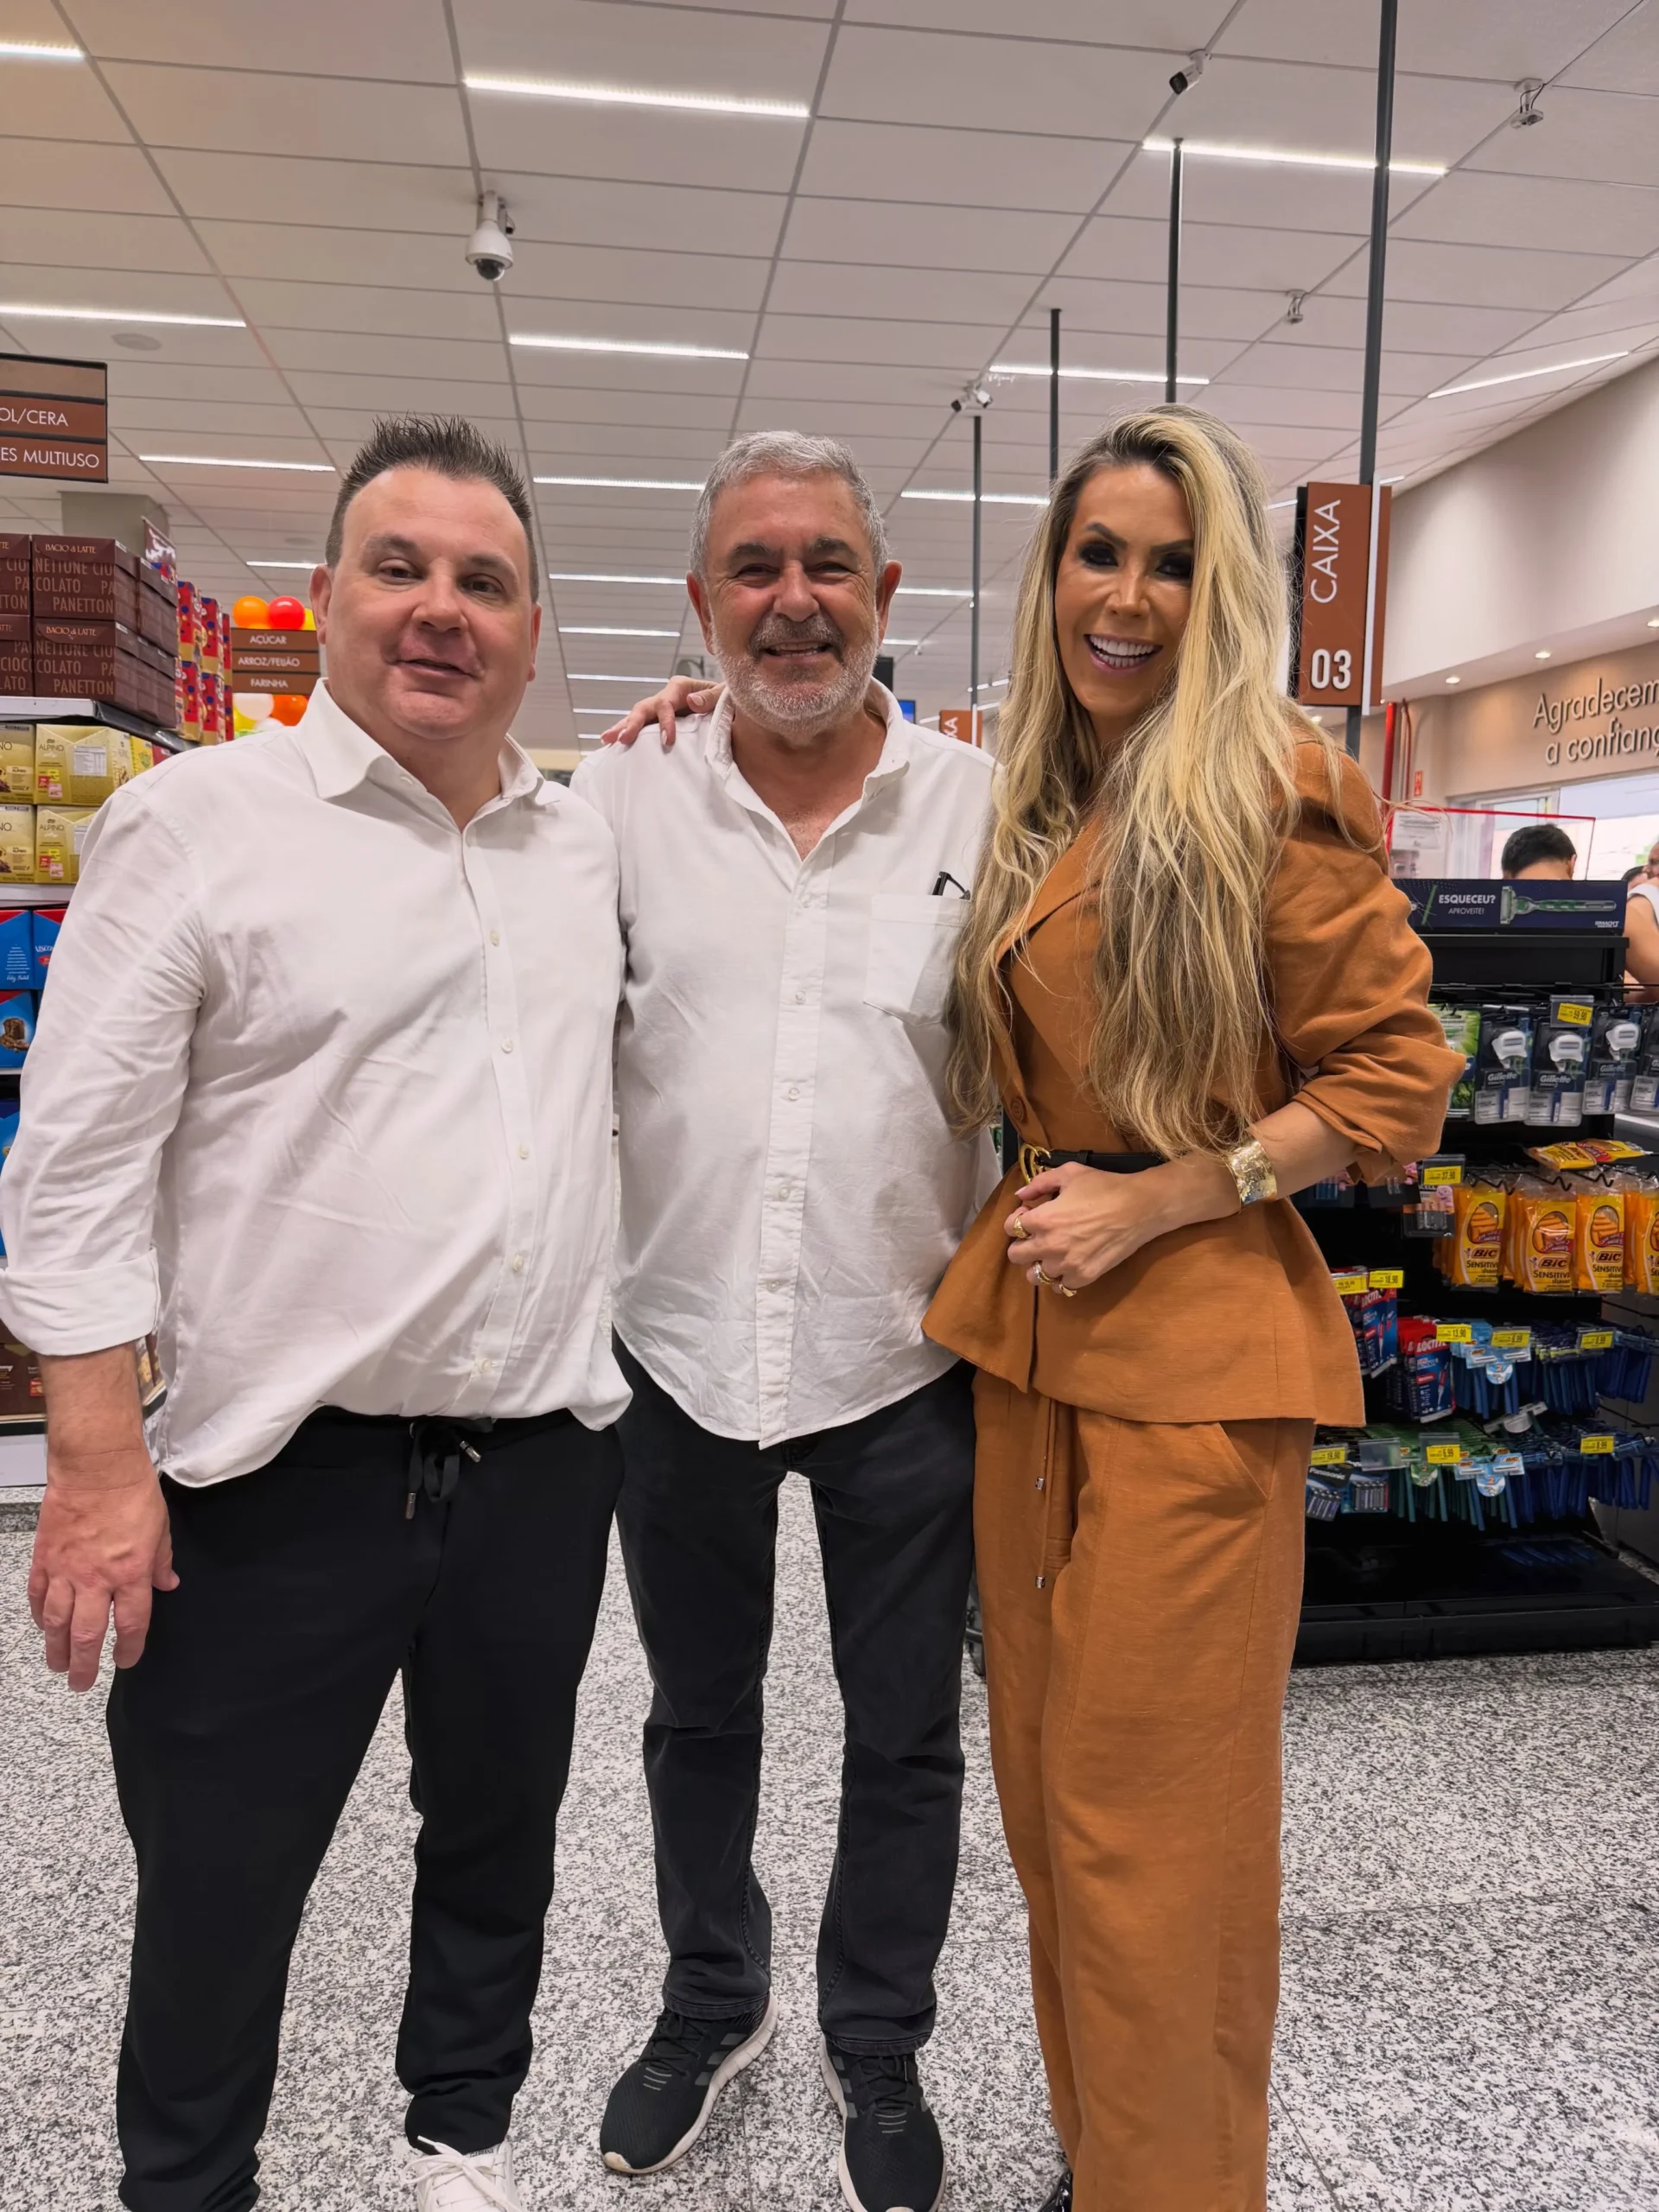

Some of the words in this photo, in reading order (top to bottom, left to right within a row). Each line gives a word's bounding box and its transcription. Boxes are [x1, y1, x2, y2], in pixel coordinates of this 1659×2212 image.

[1, 447, 18, 462] ES
[23, 449, 99, 468] MULTIUSO
[45, 543, 69, 553] BACIO
[1311, 499, 1341, 603] CAIXA
[46, 626, 69, 635] BACIO
[250, 633, 287, 646] AÇÚCAR
[238, 655, 300, 667] ARROZ/FEIJÃO
[1311, 649, 1351, 690] 03
[250, 678, 289, 689] FARINHA
[1545, 742, 1560, 766] a
[1439, 894, 1496, 906] ESQUECEU?
[1448, 906, 1484, 915] APROVEITE!
[1600, 1064, 1626, 1073] Gillette
[1487, 1071, 1517, 1082] Gillette
[1540, 1074, 1571, 1084] Gillette
[1474, 1249, 1497, 1258] BIC
[1599, 1253, 1622, 1262] BIC
[1542, 1259, 1567, 1268] BIC
[1309, 1467, 1345, 1480] Panasonic
